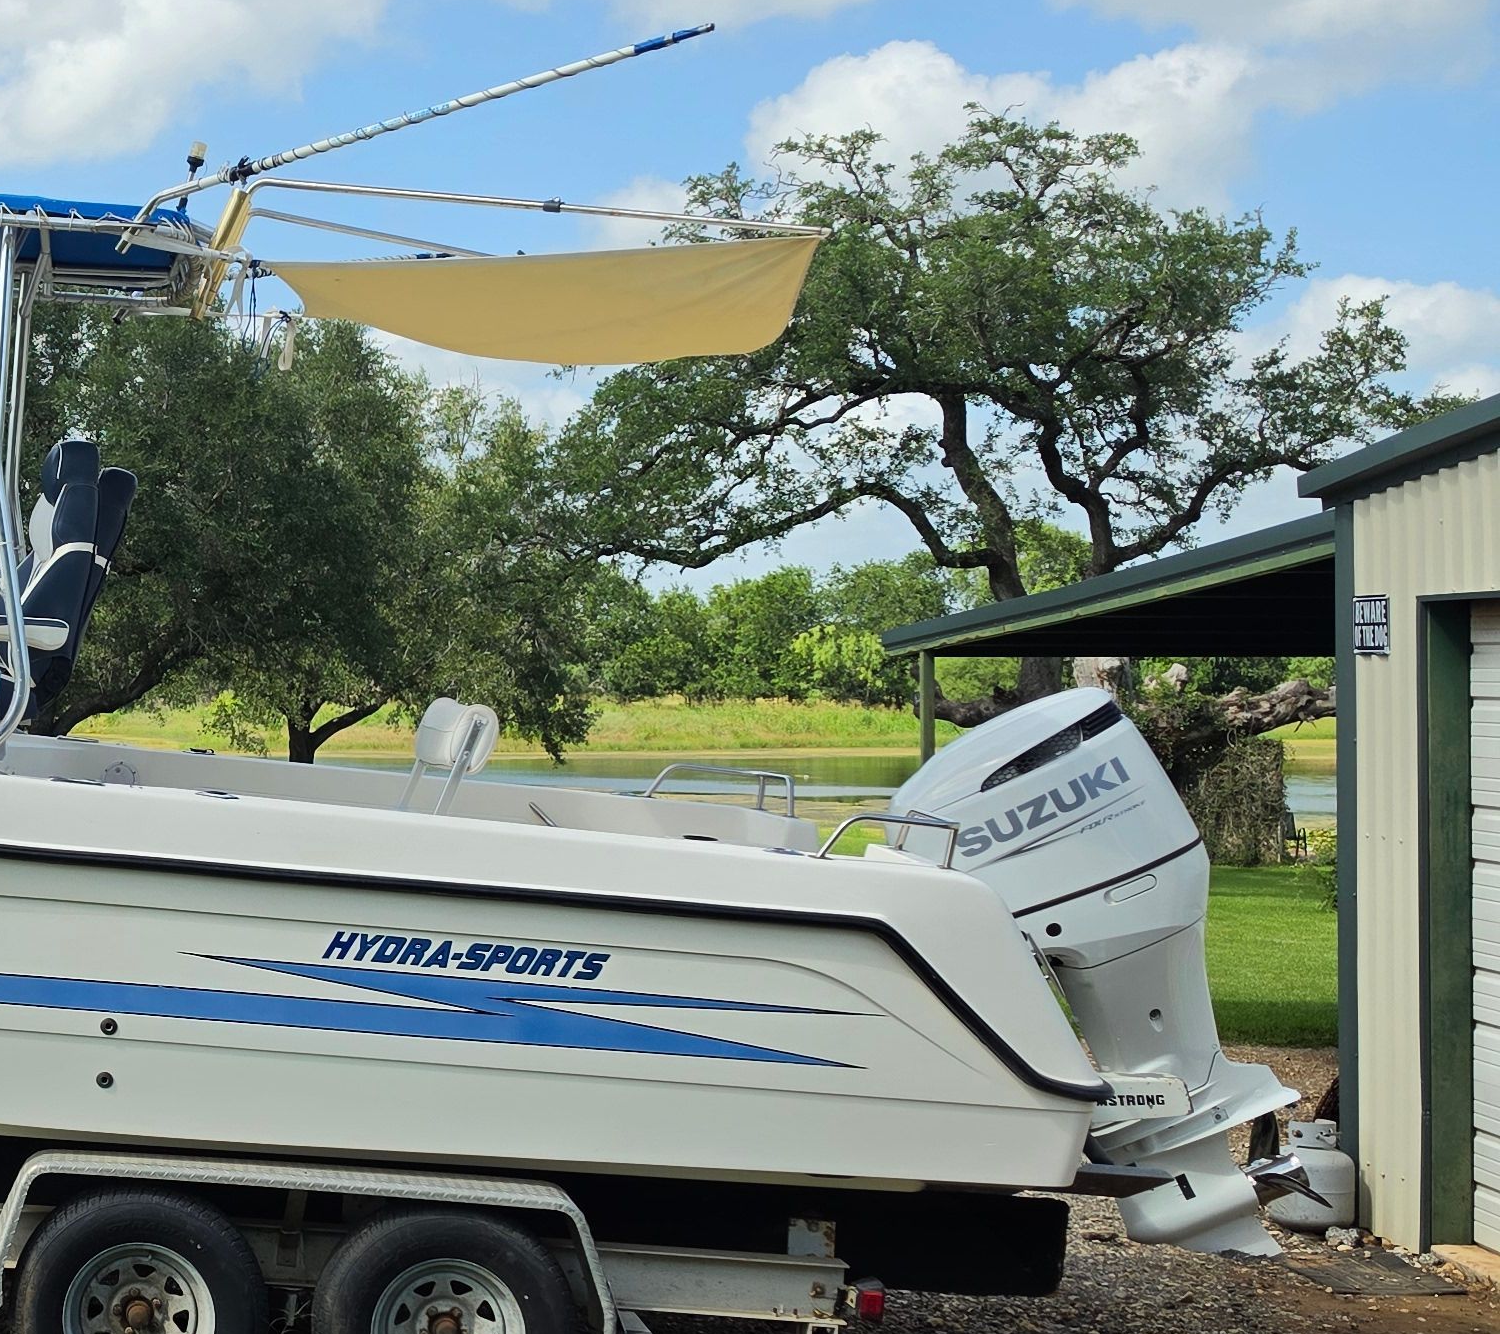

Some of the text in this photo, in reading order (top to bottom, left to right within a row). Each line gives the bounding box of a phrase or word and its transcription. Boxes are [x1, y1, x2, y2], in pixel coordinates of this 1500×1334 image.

[1355, 600, 1387, 624] BEWARE
[1354, 624, 1388, 647] OF THE DOG
[956, 756, 1131, 857] SUZUKI
[322, 931, 611, 980] HYDRA-SPORTS
